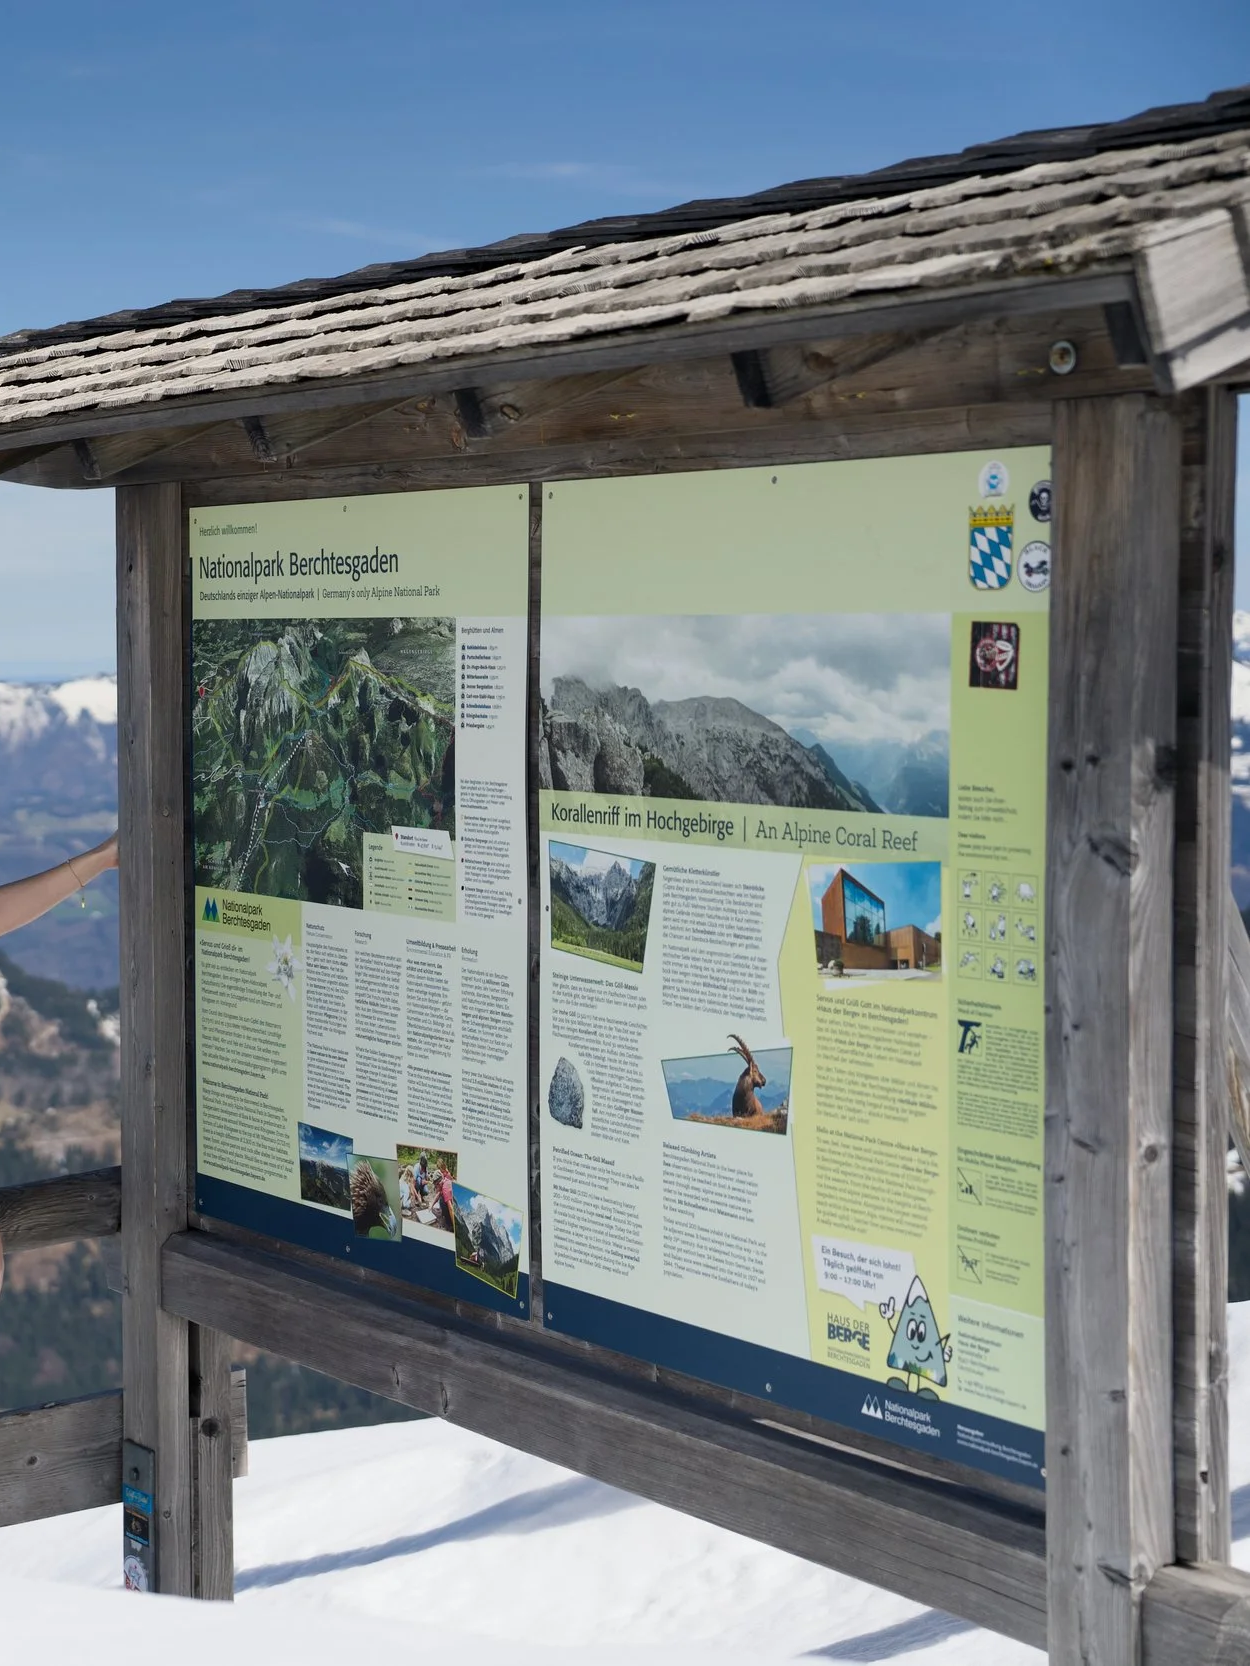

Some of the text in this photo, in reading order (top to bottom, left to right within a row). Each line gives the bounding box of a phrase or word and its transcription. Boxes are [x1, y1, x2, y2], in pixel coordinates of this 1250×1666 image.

[199, 522, 258, 537] Herzlich willkommen!
[199, 545, 399, 585] Nationalpark Berchtesgaden
[199, 589, 236, 601] Deutschlands
[236, 589, 259, 603] einziger
[259, 587, 315, 603] Alpen-Nationalpark
[356, 586, 371, 601] only
[370, 586, 393, 601] Alpine
[393, 585, 423, 597] National
[424, 584, 440, 597] Park
[482, 626, 491, 634] und
[551, 801, 917, 852] Korallenriff im Hochgebirge An Alpine Coral Reef
[222, 899, 263, 916] Nationalpark
[222, 912, 271, 932] Berchtesgaden
[834, 997, 846, 1006] und
[872, 1002, 881, 1011] im
[821, 1245, 901, 1272] Ein Besuch, der sich lohnt!
[823, 1257, 884, 1280] Täglich geöffnet von
[824, 1271, 838, 1281] 9:00
[844, 1276, 862, 1287] 17:00
[862, 1279, 876, 1290] Uhr!
[826, 1311, 870, 1333] HAUS DER
[827, 1322, 870, 1352] BERGE
[884, 1399, 931, 1423] Nationalpark
[884, 1410, 941, 1438] Berchtesgaden
